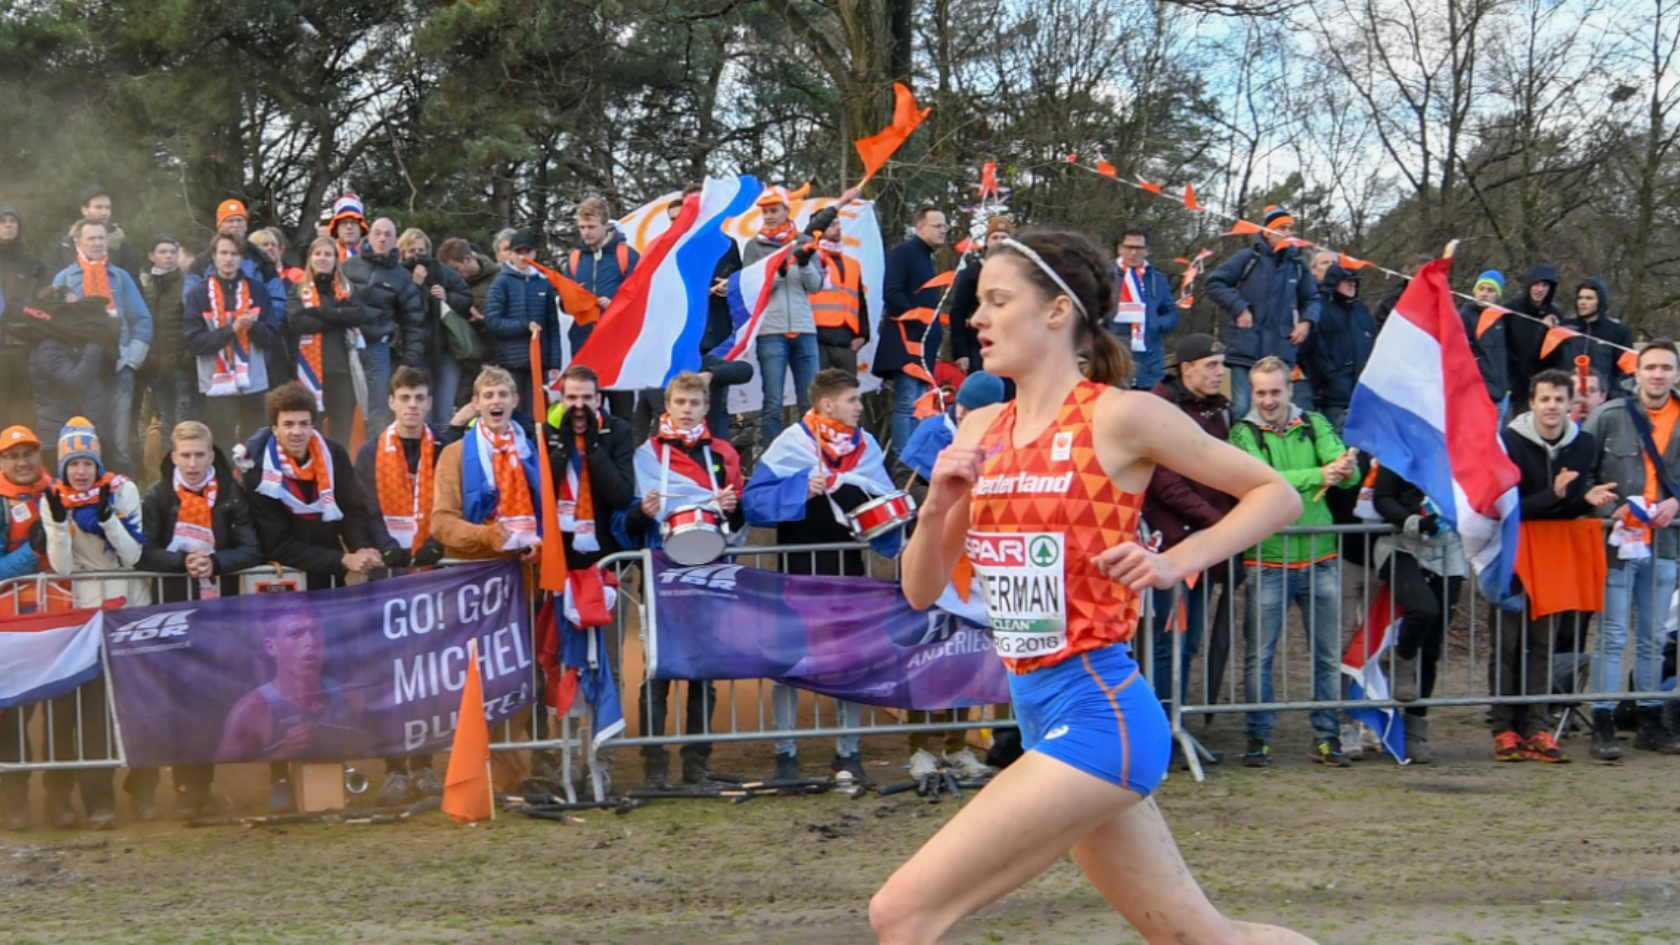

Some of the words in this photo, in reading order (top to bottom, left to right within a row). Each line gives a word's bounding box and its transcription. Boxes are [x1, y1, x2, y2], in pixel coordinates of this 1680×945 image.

[965, 537, 1025, 563] SPAR
[657, 570, 738, 591] TDR
[383, 592, 446, 640] GO!
[457, 574, 511, 624] GO!
[108, 622, 190, 643] TDR
[992, 619, 1031, 632] CLEAN
[1015, 635, 1060, 653] 2018
[393, 622, 531, 705] MICHEL
